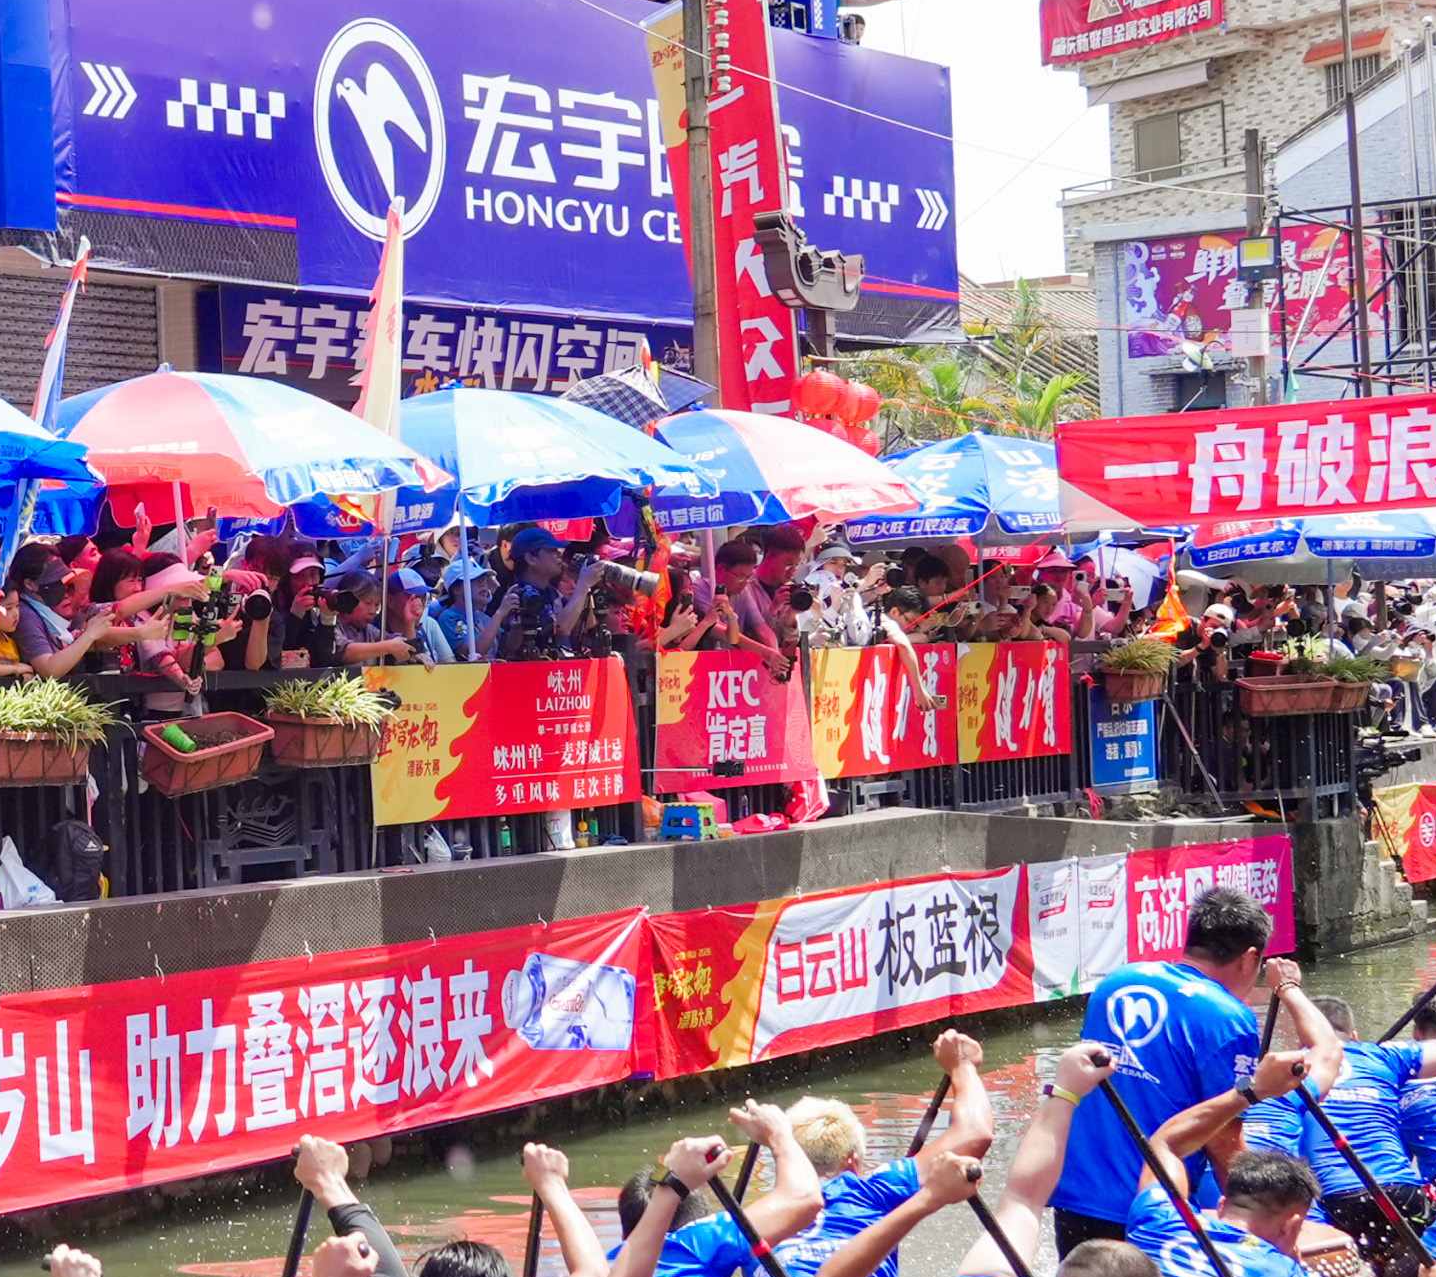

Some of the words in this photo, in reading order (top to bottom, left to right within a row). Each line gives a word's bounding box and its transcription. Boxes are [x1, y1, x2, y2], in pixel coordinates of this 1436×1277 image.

[464, 185, 630, 238] HONGYU
[535, 694, 591, 713] LAIZHOU
[706, 668, 761, 709] KFC
[774, 926, 869, 1006] 白云山
[874, 889, 1007, 998] 板蓝根
[125, 958, 494, 1153] 助力叠滘逐浪来
